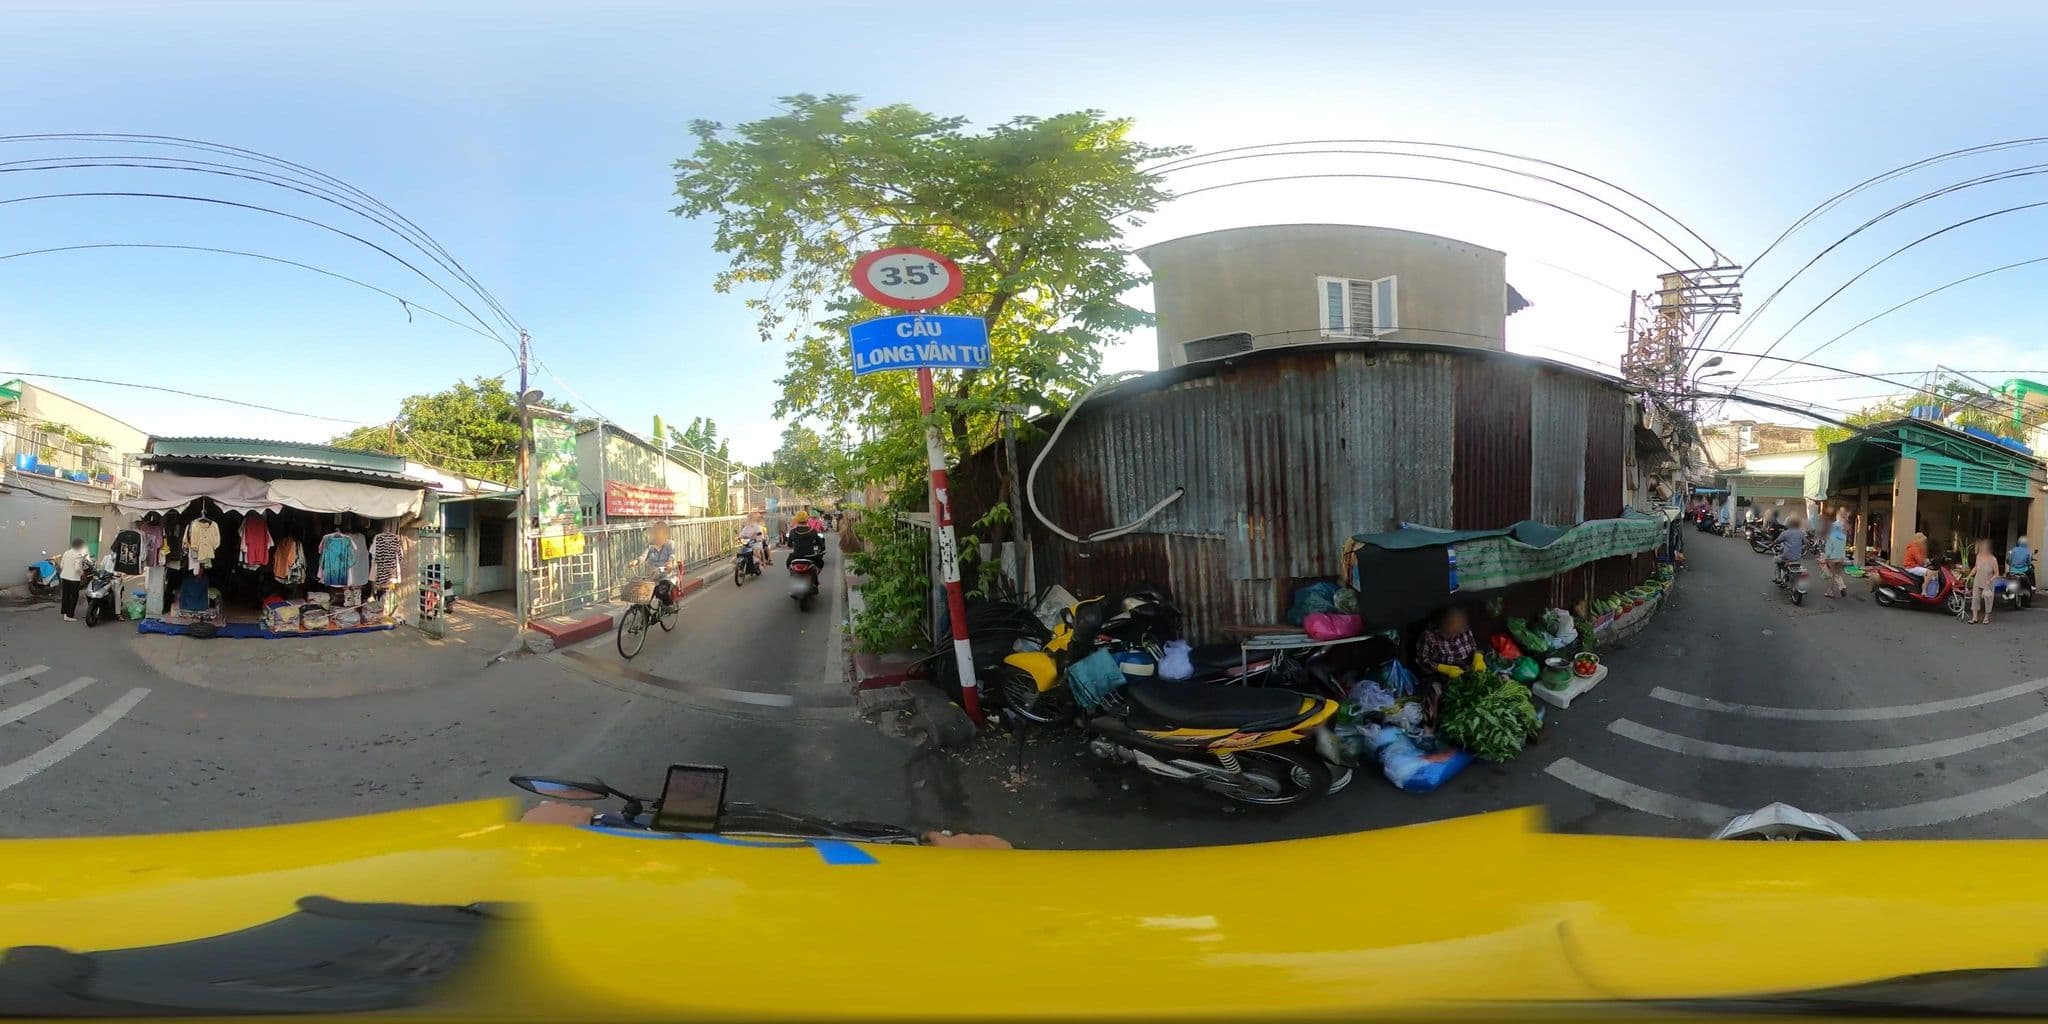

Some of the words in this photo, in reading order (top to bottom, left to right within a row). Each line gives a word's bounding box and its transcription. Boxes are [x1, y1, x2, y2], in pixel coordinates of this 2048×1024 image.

[896, 317, 942, 338] CẦU
[856, 345, 915, 369] LONG
[915, 340, 957, 362] VÂN
